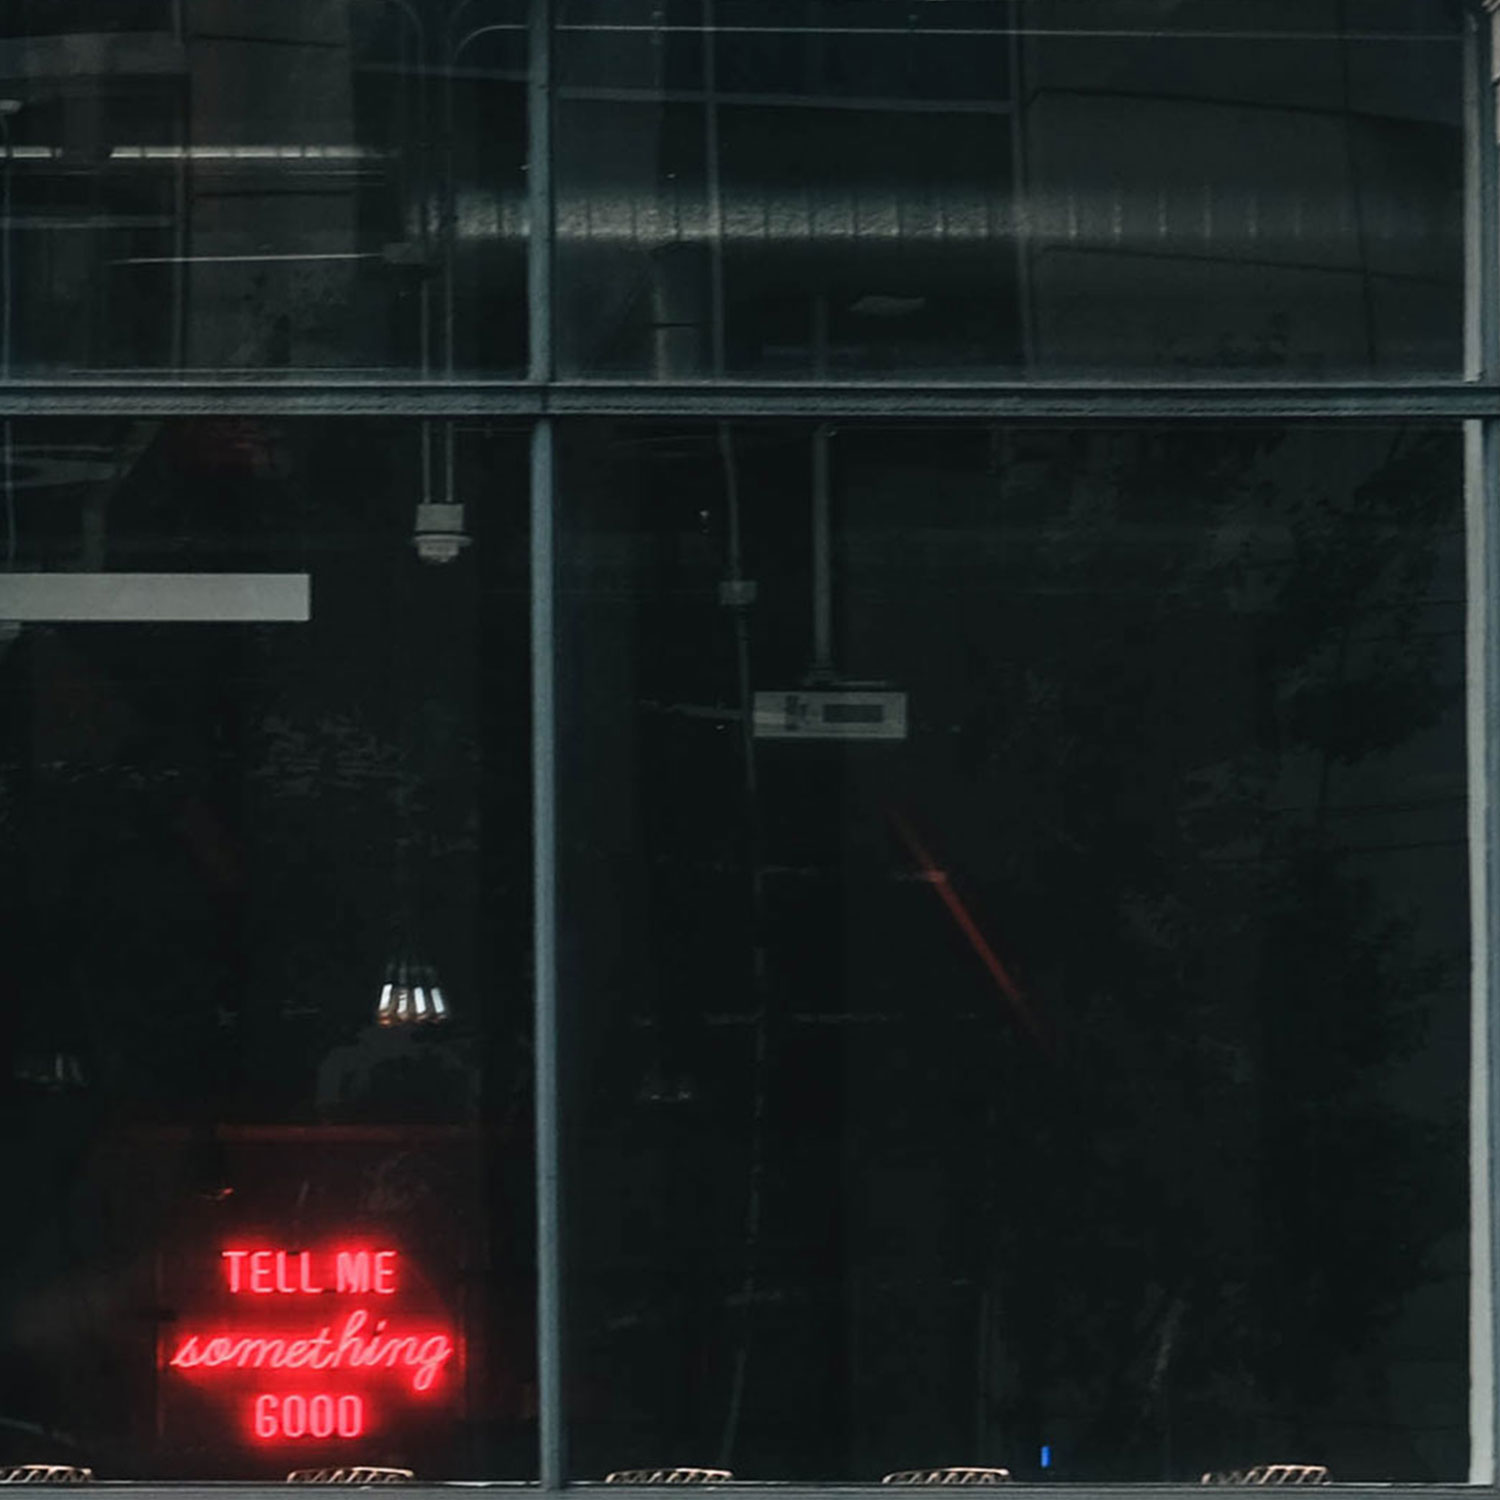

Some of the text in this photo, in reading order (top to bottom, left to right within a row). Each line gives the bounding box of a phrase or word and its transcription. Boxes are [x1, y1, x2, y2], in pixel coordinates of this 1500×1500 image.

[221, 1250, 398, 1294] TELL ME
[168, 1308, 454, 1391] something
[254, 1393, 364, 1439] GOOD
